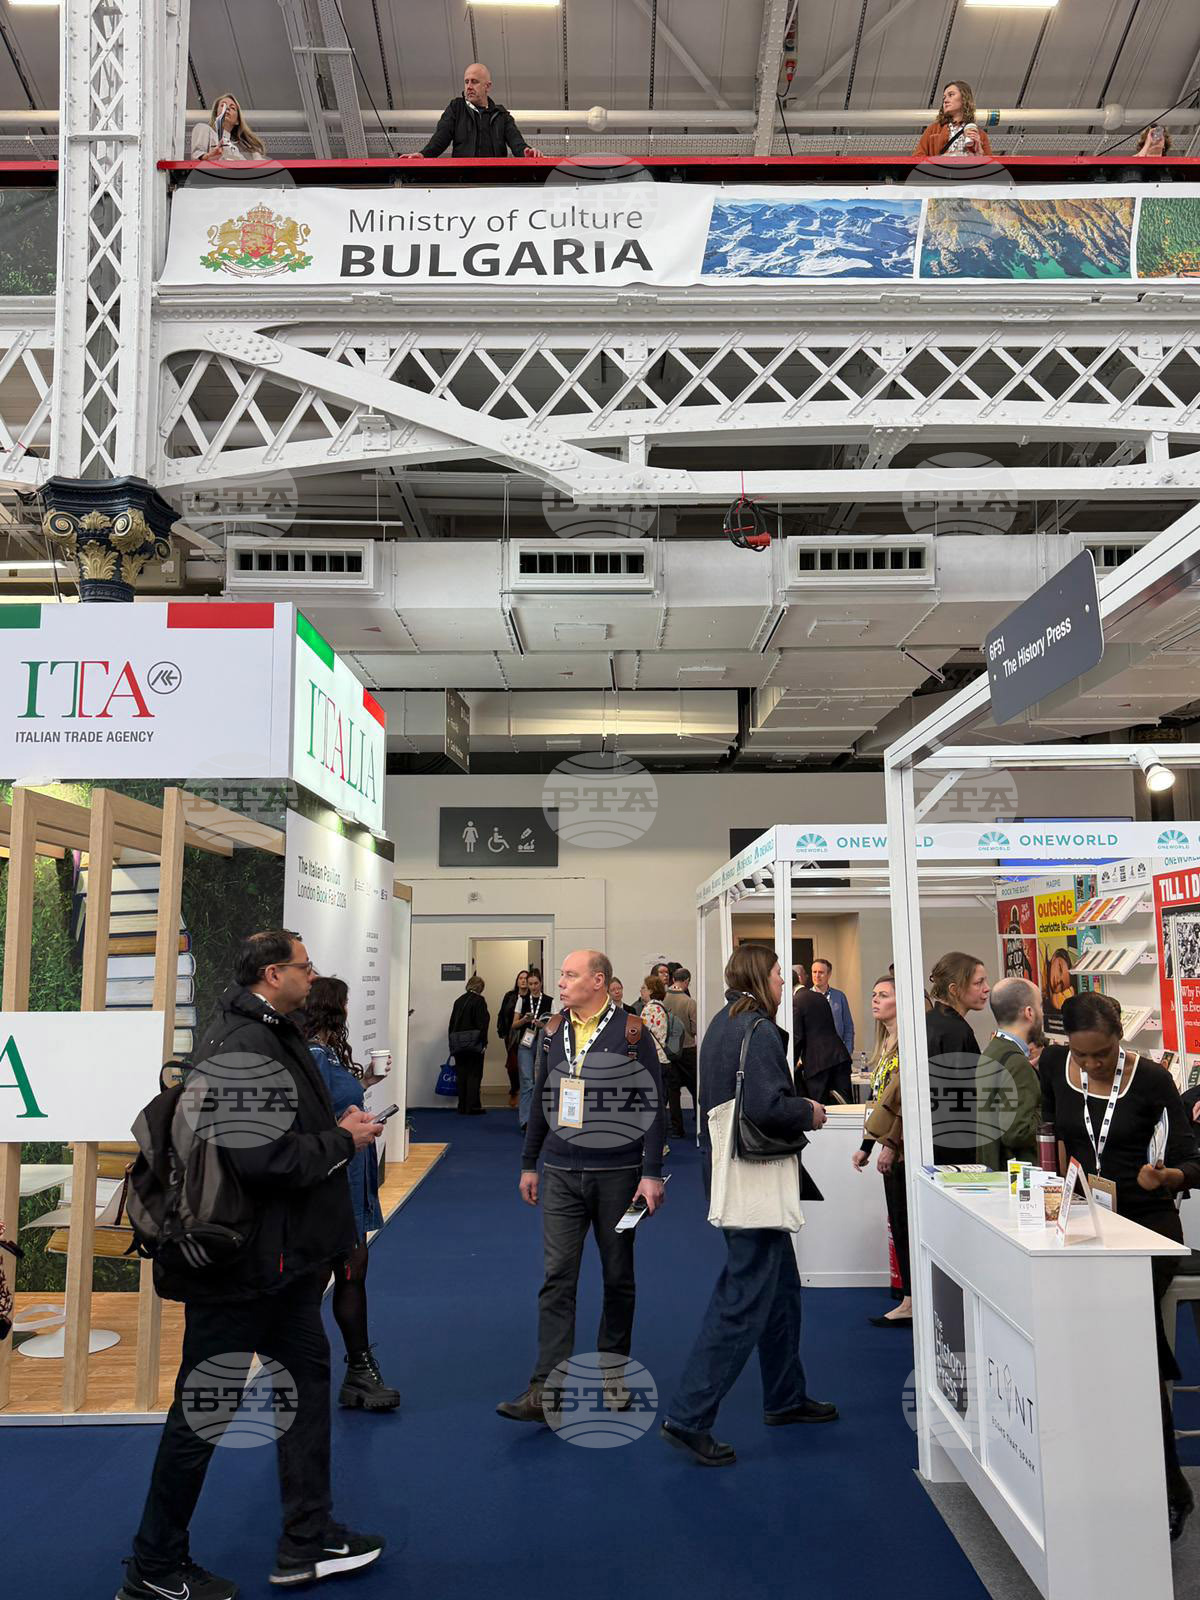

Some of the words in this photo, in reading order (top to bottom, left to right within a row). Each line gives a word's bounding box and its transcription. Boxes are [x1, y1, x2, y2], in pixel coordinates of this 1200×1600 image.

[349, 208, 476, 239] Ministry
[486, 208, 519, 233] of
[528, 205, 643, 231] Culture
[339, 238, 654, 278] BULGARIA
[988, 635, 1006, 661] 6F51
[1002, 658, 1018, 678] The
[1017, 636, 1045, 668] History
[1046, 616, 1072, 647] Press
[17, 660, 156, 718] ITA
[15, 731, 61, 743] ITALIAN
[64, 731, 103, 743] TRADE
[106, 730, 155, 743] AGENCY
[306, 678, 377, 805] ITALIA
[836, 836, 935, 848] ONEWLD
[1019, 834, 1119, 847] ONEWORLD
[1158, 876, 1185, 902] TILL
[1037, 894, 1073, 918] outside
[933, 1311, 944, 1333] The
[935, 1328, 966, 1388] History
[936, 1354, 959, 1403] Press
